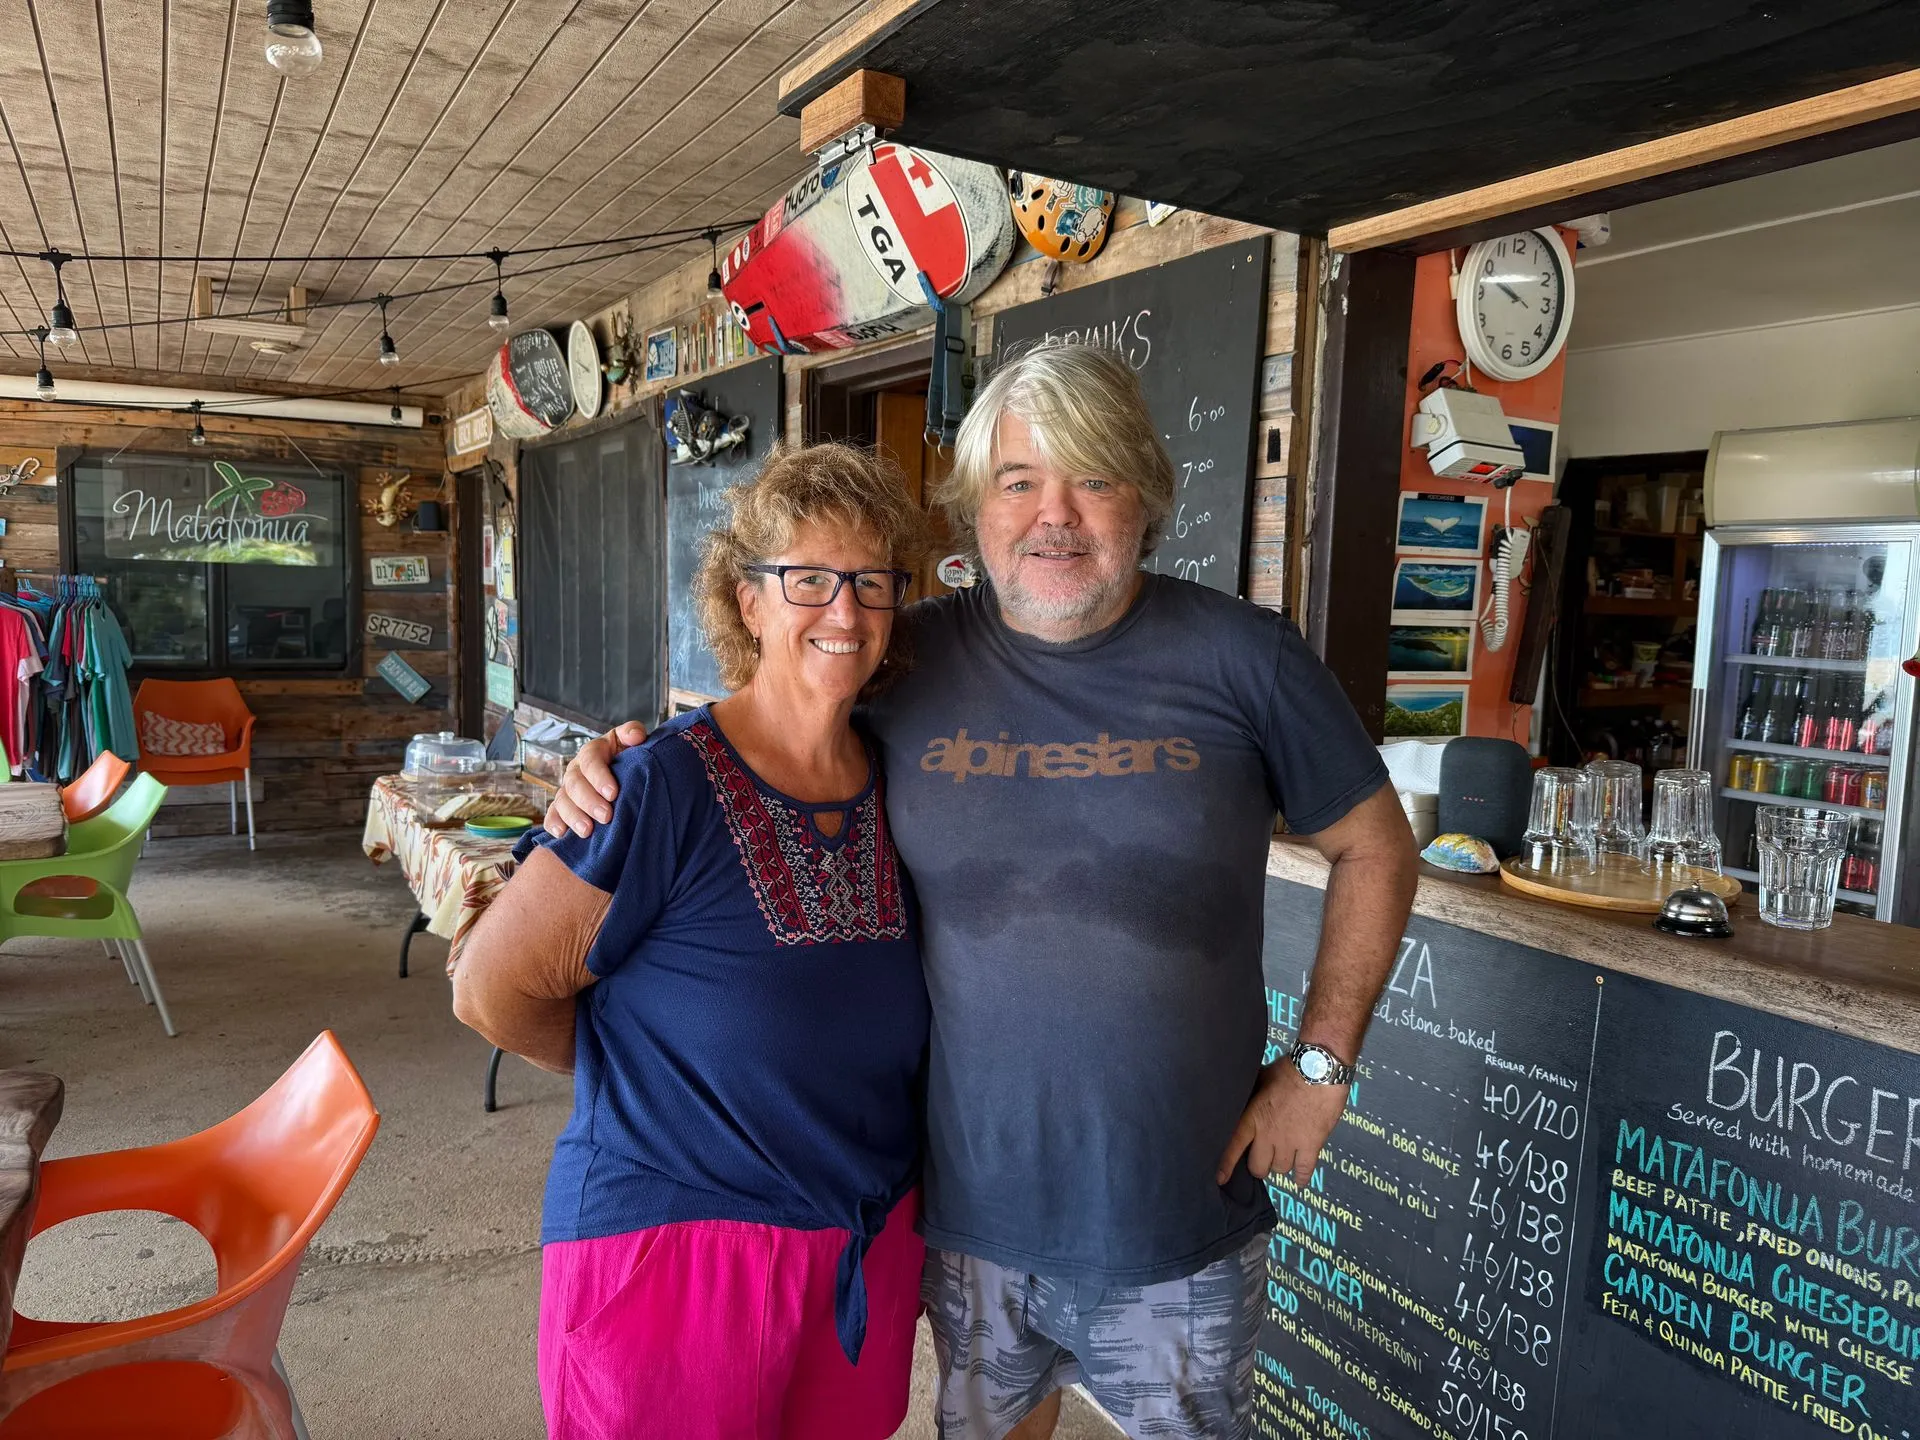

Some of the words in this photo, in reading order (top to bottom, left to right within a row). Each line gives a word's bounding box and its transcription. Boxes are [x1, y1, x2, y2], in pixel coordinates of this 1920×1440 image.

[784, 172, 820, 215] Hydro
[858, 194, 906, 285] TGA
[1485, 259, 1494, 275] 0
[1497, 241, 1507, 258] 11
[1513, 238, 1526, 255] 12
[1533, 249, 1538, 265] 1
[1540, 298, 1550, 314] 3
[1541, 272, 1551, 287] 2
[1046, 310, 1151, 370] NKS
[1486, 335, 1495, 347] 7
[1502, 344, 1512, 360] 6
[1520, 341, 1531, 356] 5
[1533, 323, 1543, 339] 4
[113, 489, 315, 557] Matafonua
[368, 616, 431, 643] SR7752
[919, 728, 1201, 783] alpinestars
[1265, 986, 1300, 1031] HEE
[1401, 1007, 1444, 1037] stone
[1448, 1019, 1498, 1054] baked
[1485, 1054, 1526, 1075] REGULAR
[1484, 1077, 1579, 1140] 40/120
[1342, 1109, 1390, 1144] SHROOM,
[1393, 1133, 1417, 1156] BBQ
[1422, 1149, 1461, 1177] SAUCE
[1477, 1131, 1568, 1205] 46/138
[1750, 1132, 1791, 1159] with
[1803, 1144, 1916, 1203] homemade
[1269, 1185, 1337, 1247] ETARIAN
[1304, 1188, 1363, 1232] PINEAPPLE
[1407, 1194, 1437, 1219] CHILI
[1469, 1177, 1563, 1254] 46/138
[1610, 1168, 1656, 1199] BEEF
[1746, 1223, 1802, 1258] FRIED
[1616, 1118, 1824, 1242] MATAFONUA
[1837, 1199, 1920, 1277] BUR
[1608, 1192, 1755, 1290] MATAFONUA
[1298, 1247, 1364, 1312] LOVER
[1462, 1233, 1554, 1308] 46/138
[1454, 1281, 1551, 1366] 46/138
[1604, 1253, 1712, 1339] GARDEN
[1729, 1310, 1872, 1419] BURGER
[1607, 1234, 1697, 1289] MATAFONUA
[1702, 1276, 1777, 1324] BURGER
[1785, 1315, 1829, 1349] WITH
[1838, 1337, 1915, 1387] CHEESE
[1357, 1318, 1422, 1374] PEPPERONI
[1448, 1327, 1490, 1360] OLIVES
[1602, 1291, 1640, 1328] FETA
[1659, 1319, 1725, 1371] QUINOA
[1803, 1394, 1855, 1434] FRIED
[1253, 1368, 1289, 1407] ERONI,
[1254, 1350, 1296, 1388] ITIONAL
[1305, 1385, 1371, 1440] TOPPINGS
[1448, 1346, 1525, 1411] 46/138
[1382, 1386, 1432, 1430] SEAFOOD
